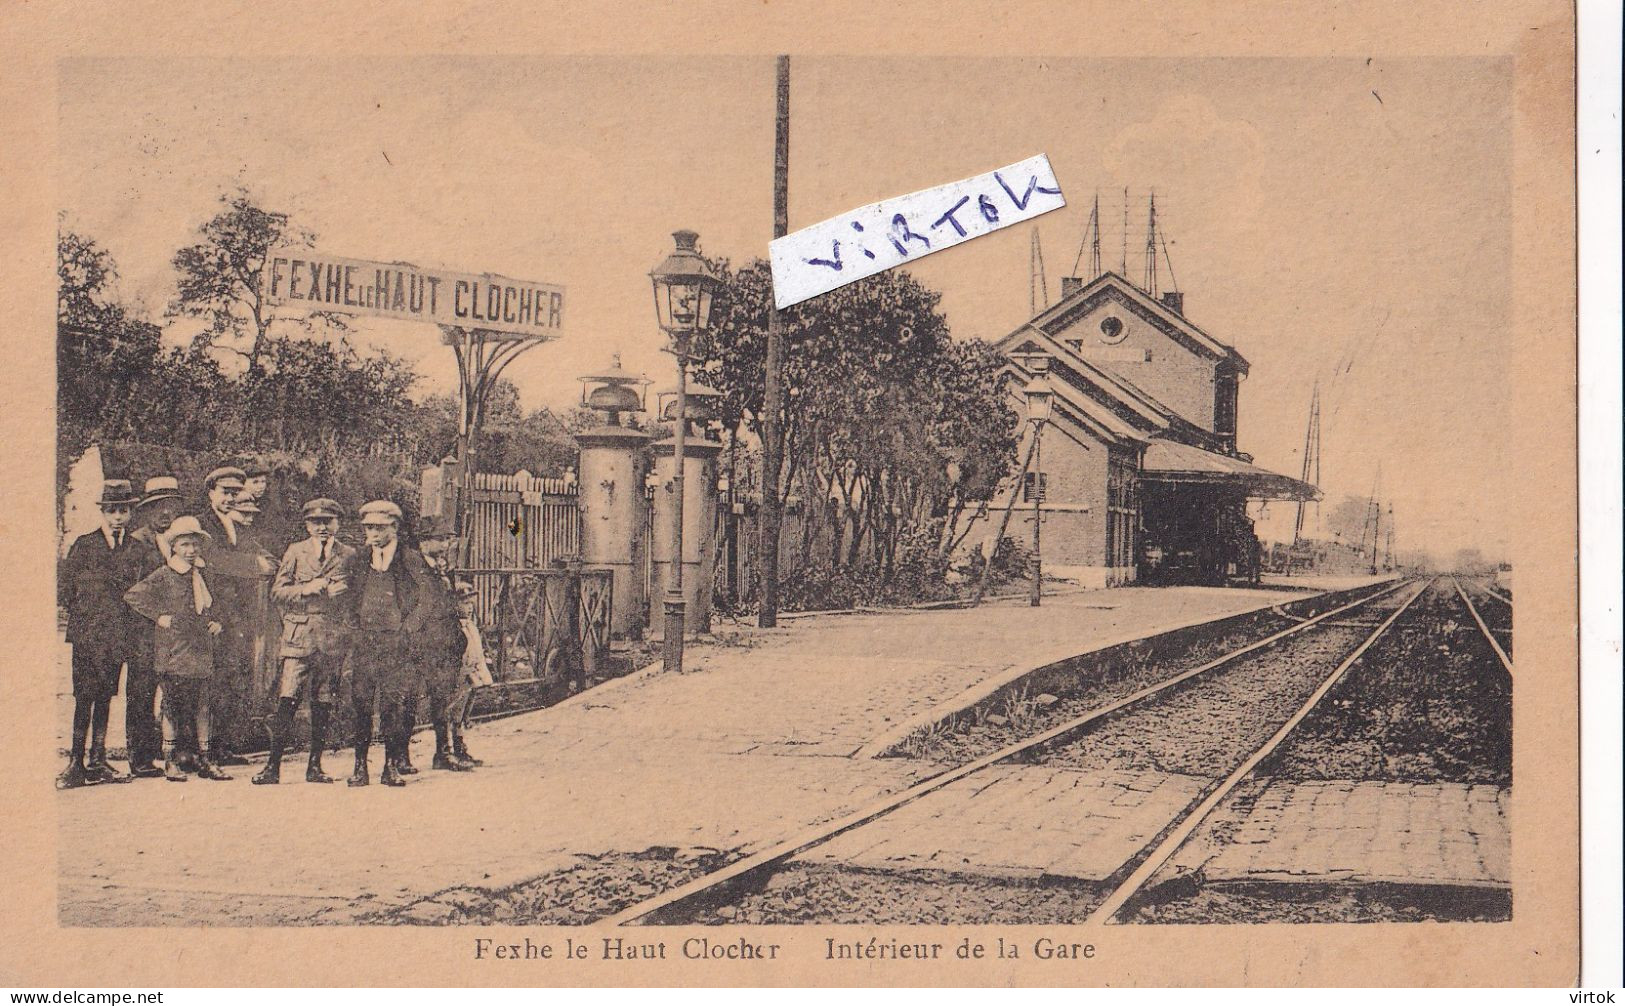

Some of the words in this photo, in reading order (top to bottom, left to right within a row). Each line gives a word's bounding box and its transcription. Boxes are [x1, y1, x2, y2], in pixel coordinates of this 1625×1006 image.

[270, 257, 359, 307] FEXHE
[374, 268, 441, 316] HAUT
[454, 279, 563, 330] CLOCHER
